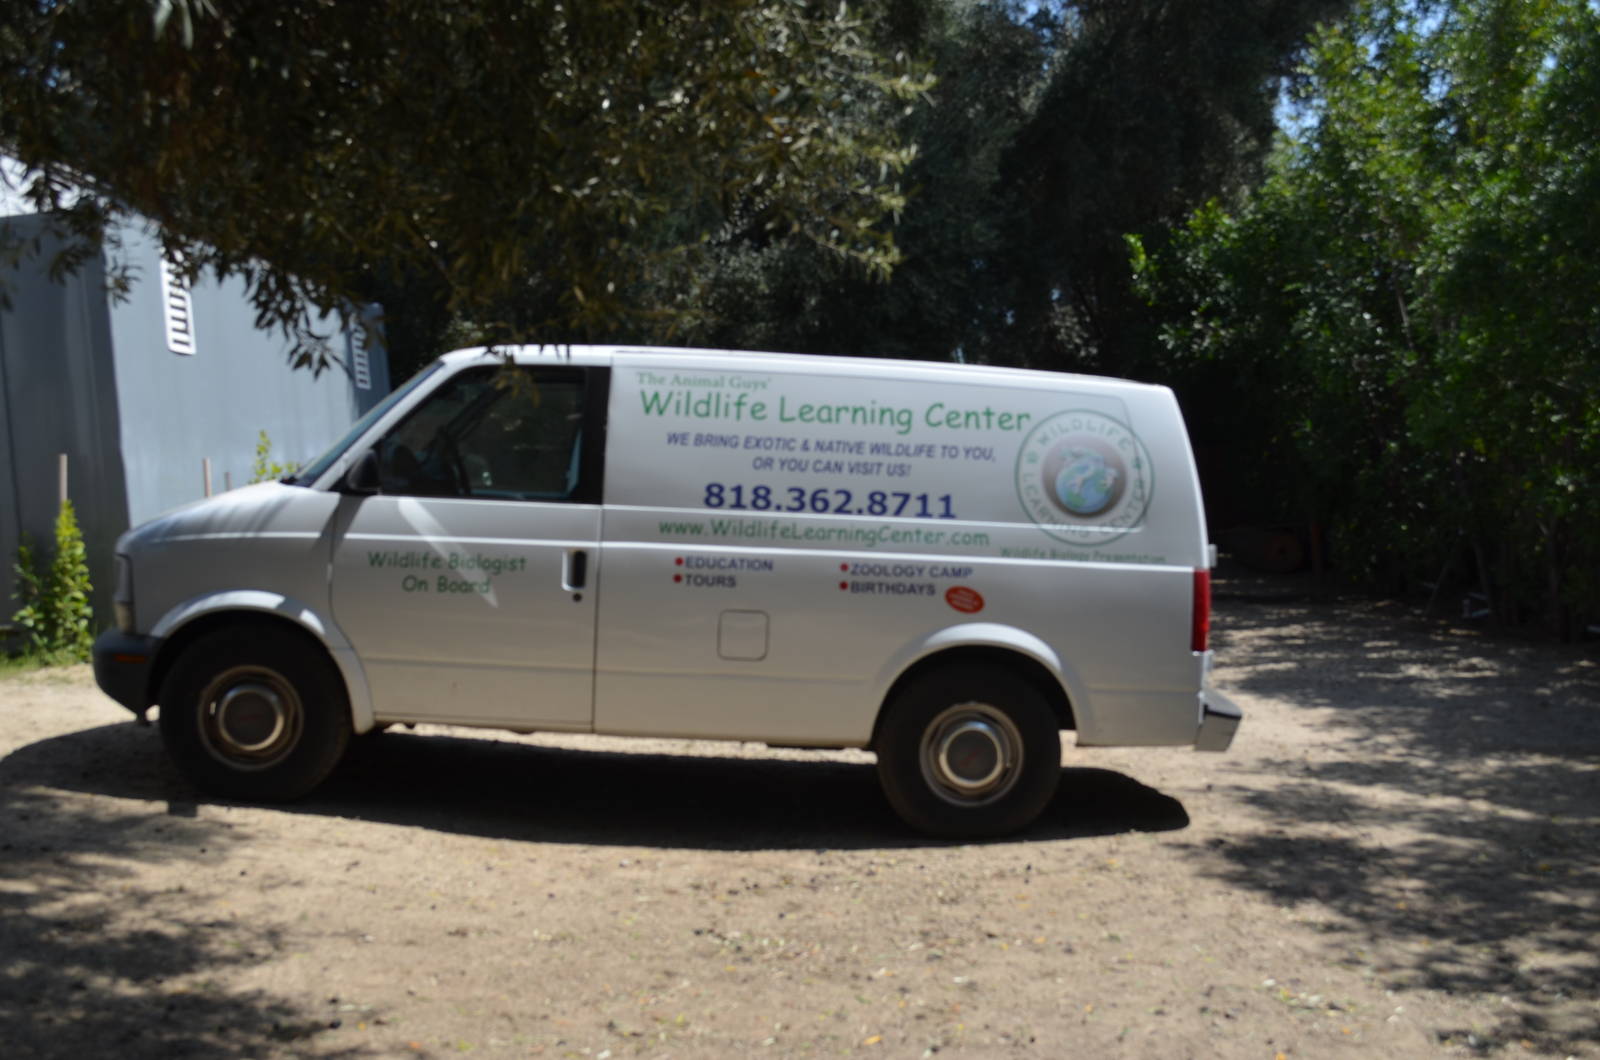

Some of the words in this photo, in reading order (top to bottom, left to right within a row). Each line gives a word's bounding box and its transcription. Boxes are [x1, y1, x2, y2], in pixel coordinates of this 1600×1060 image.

[637, 372, 666, 385] The
[670, 374, 725, 388] Animal
[640, 389, 768, 421] Wildlife
[779, 396, 913, 435] Learning
[925, 401, 1031, 431] Center
[1038, 417, 1132, 451] WILDLIFE
[667, 432, 690, 446] WE
[694, 433, 739, 448] BRING
[743, 435, 796, 451] EXOTIC
[802, 437, 810, 452] &
[814, 439, 865, 455] NATIVE
[869, 441, 936, 458] WILDLIFE
[941, 444, 959, 460] TO
[963, 446, 996, 463] YOU,
[752, 456, 774, 470] OR
[779, 457, 809, 472] YOU
[813, 459, 843, 474] CAN
[848, 460, 881, 476] VISIT
[887, 463, 911, 478] US!
[703, 482, 956, 519] 818.362.8711
[658, 518, 990, 547] www.WildlifeLearningCenter.com
[368, 551, 442, 569] Wildlife
[448, 552, 528, 575] Biologist
[685, 556, 774, 571] EDUCATION
[851, 563, 925, 578] ZOOLOGY
[929, 565, 974, 580] CAMP
[402, 574, 428, 593] On
[437, 575, 491, 594] Board
[685, 573, 737, 588] TOURS
[849, 580, 936, 597] BIRTHDAYS
